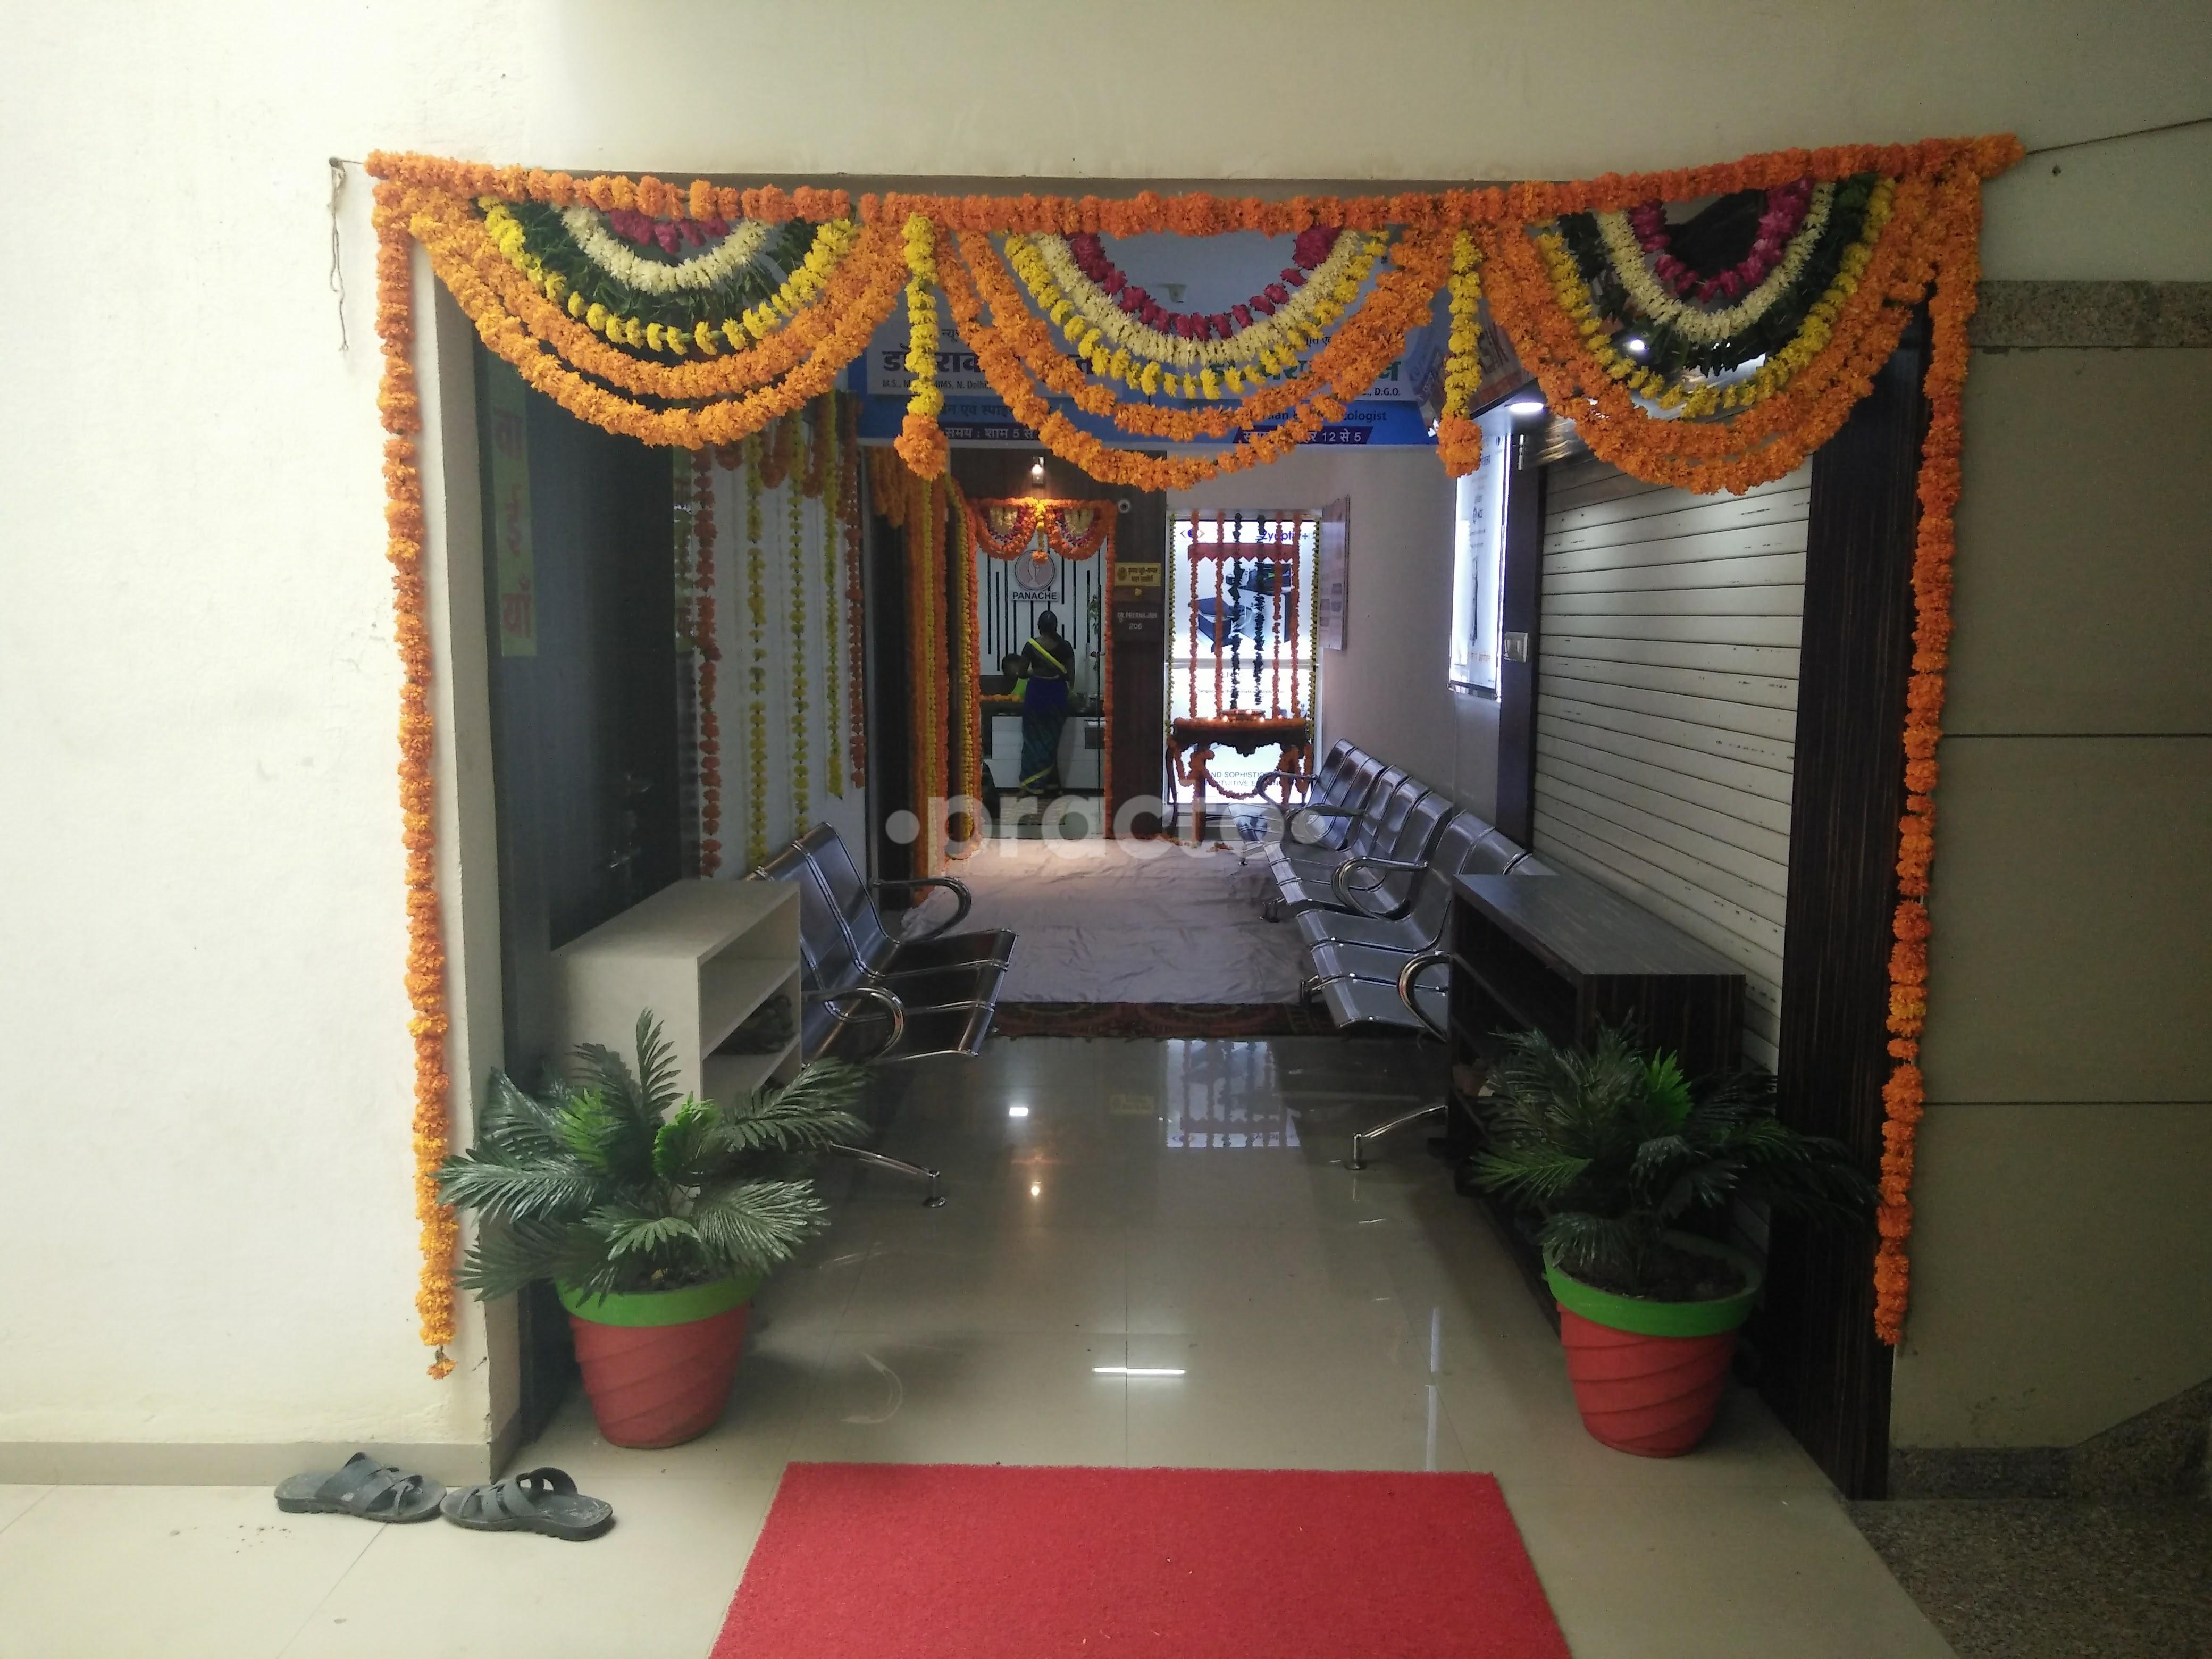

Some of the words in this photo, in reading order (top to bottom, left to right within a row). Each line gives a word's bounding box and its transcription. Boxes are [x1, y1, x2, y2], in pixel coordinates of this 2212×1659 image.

[1375, 387, 1401, 396] D.G.O.
[1322, 431, 1336, 442] 12
[1339, 428, 1351, 442] से
[1354, 432, 1362, 442] 5
